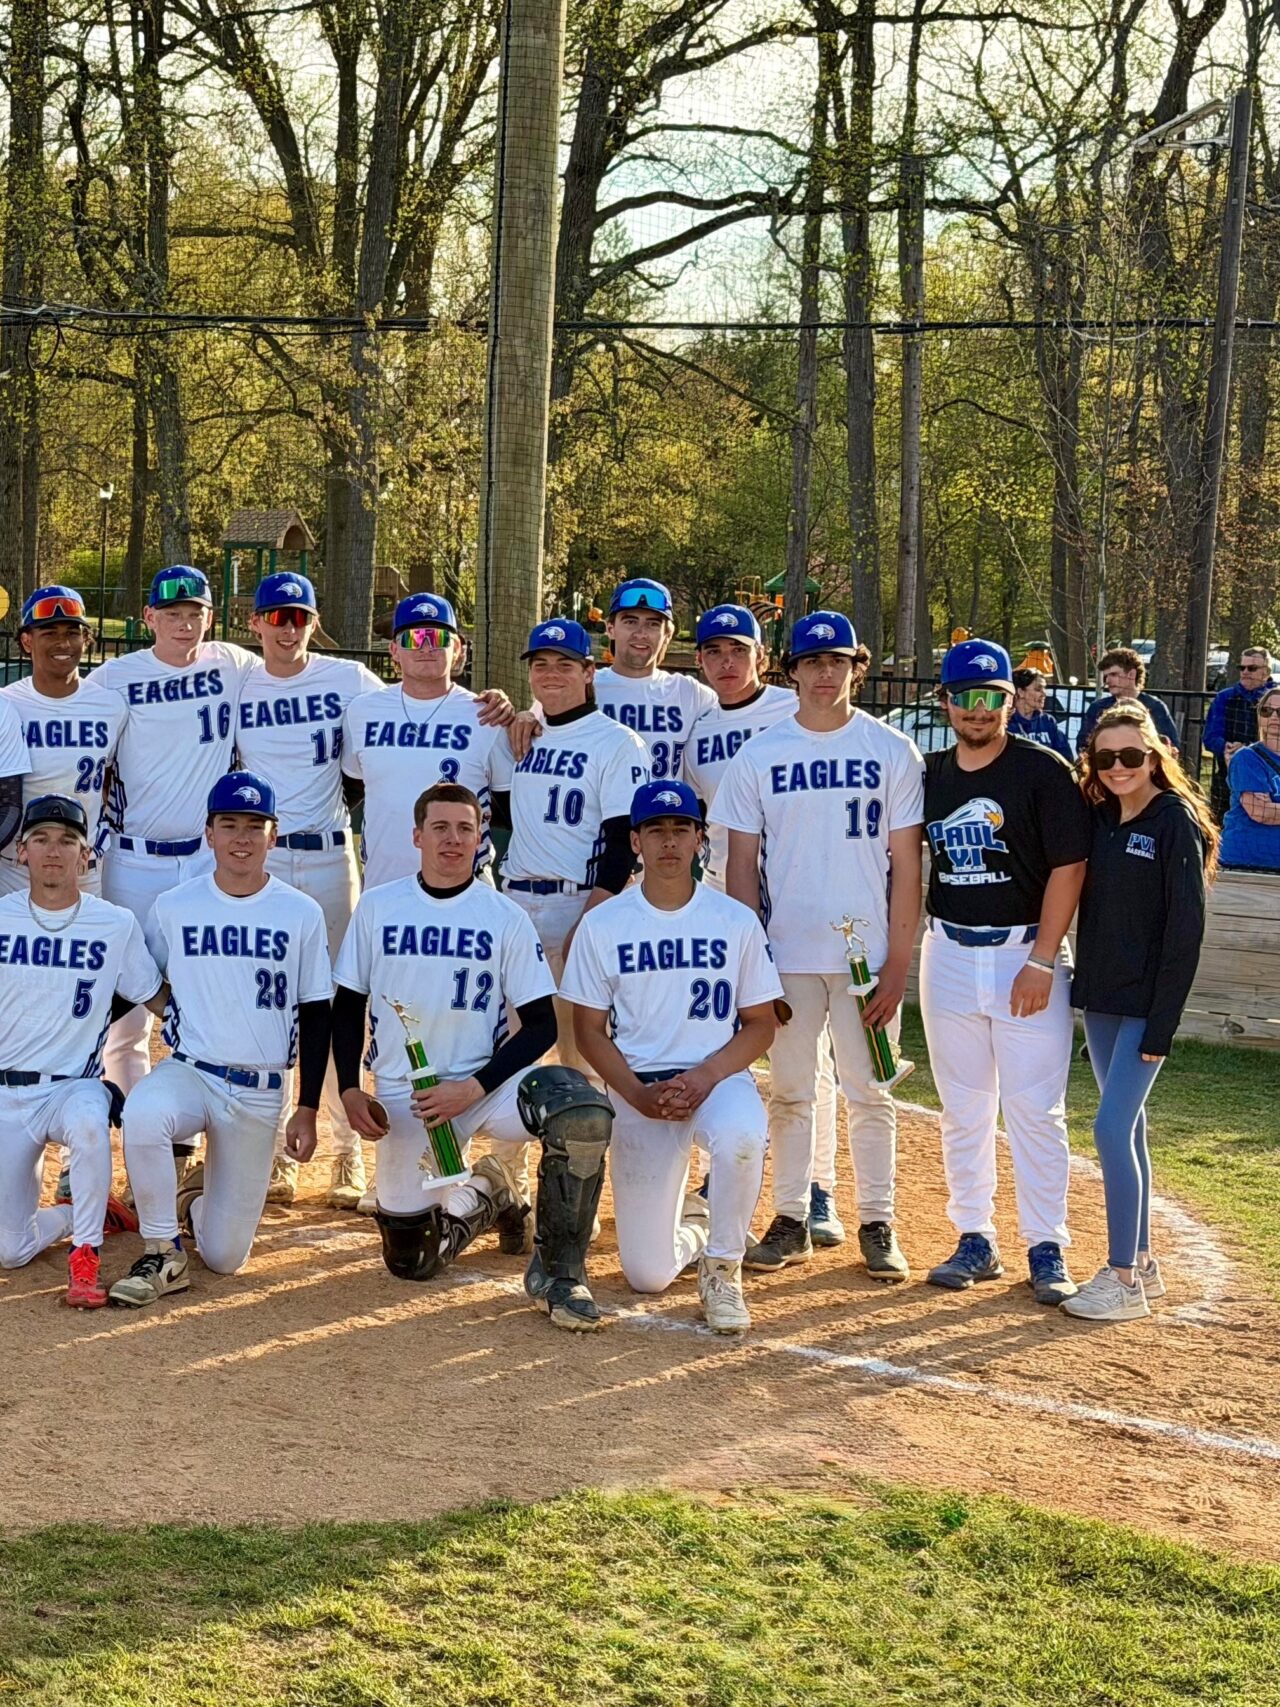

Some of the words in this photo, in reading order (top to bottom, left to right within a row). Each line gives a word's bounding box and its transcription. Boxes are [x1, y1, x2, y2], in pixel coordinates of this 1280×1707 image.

[128, 669, 223, 705] EAGLES
[197, 701, 231, 744] 16
[240, 692, 342, 730] EAGLES
[603, 704, 683, 733] AGLES
[21, 719, 108, 748] AGLES
[311, 727, 343, 766] 15
[364, 721, 472, 750] EAGLES
[651, 740, 685, 779] 35
[771, 759, 881, 794] EAGLES
[544, 783, 585, 827] 10
[845, 797, 882, 839] 19
[926, 820, 1009, 857] PAUL
[944, 846, 984, 868] VI
[182, 925, 289, 962] EAGLES
[382, 925, 493, 961] EAGLES
[617, 937, 728, 973] EAGLES
[71, 978, 97, 1019] 5
[255, 968, 288, 1010] 28
[451, 967, 494, 1013] 12
[688, 978, 732, 1021] 20
